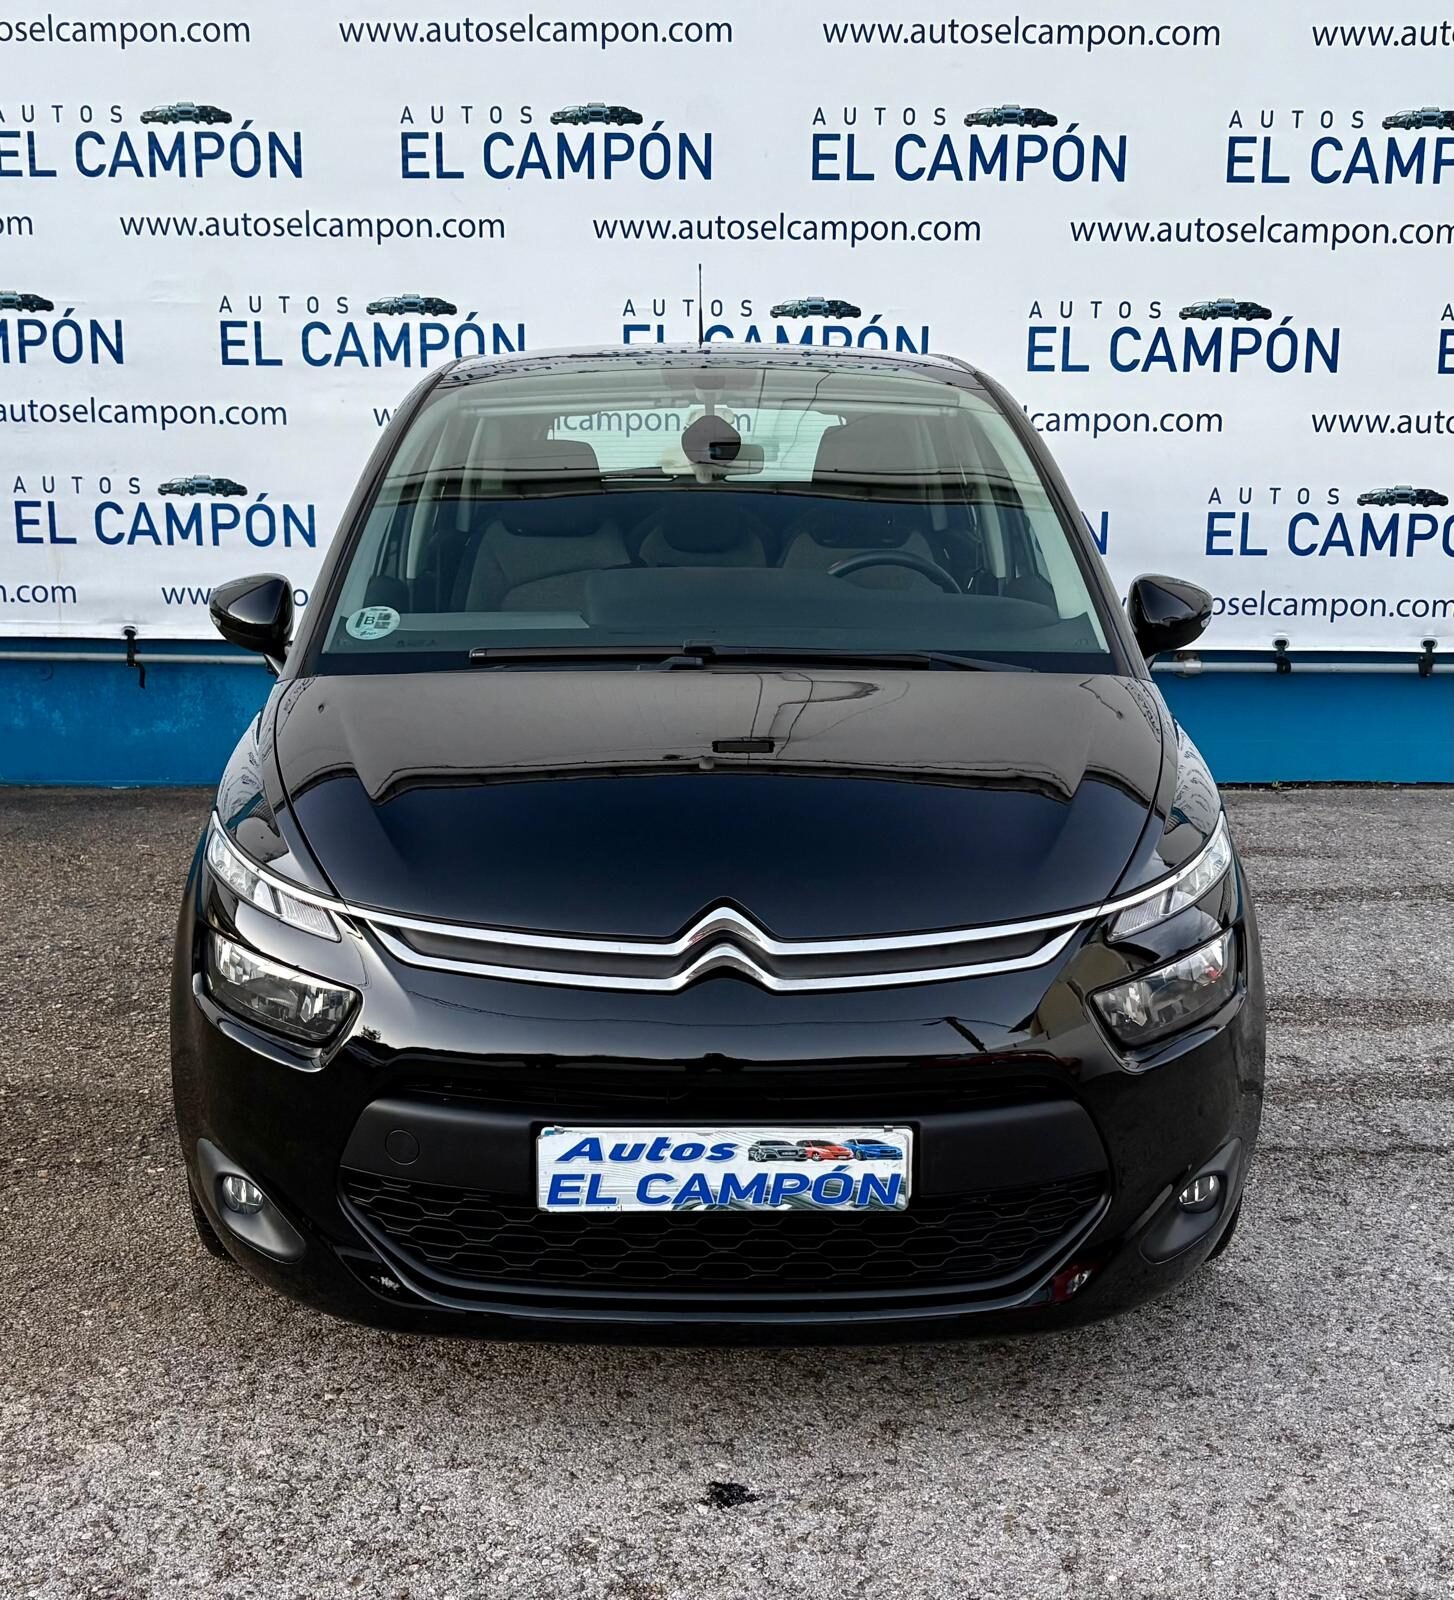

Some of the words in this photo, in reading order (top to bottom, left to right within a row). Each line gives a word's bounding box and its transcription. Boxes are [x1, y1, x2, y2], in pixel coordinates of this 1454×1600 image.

[338, 13, 732, 50] www.autoselcampon.com
[822, 15, 1220, 53] www.autoselcampon.com
[1312, 20, 1454, 47] www.aut
[400, 105, 533, 125] AUTOS
[812, 106, 946, 126] AUTOS
[1228, 109, 1364, 129] AUTOS
[0, 130, 58, 178] EL
[75, 119, 303, 179] CAMPÓN
[400, 131, 465, 179] EL
[483, 119, 712, 181] CAMPÓN
[811, 133, 875, 181] EL
[894, 122, 1127, 183] CAMPÓN
[1226, 135, 1290, 184] EL
[119, 209, 505, 245] www.autoselcampon.com
[592, 212, 981, 246] www.autoselcampon.com
[1070, 214, 1454, 248] www.autoselcampon.com
[218, 295, 349, 314] AUTOS
[622, 298, 753, 318] AUTOS
[1028, 300, 1162, 319] AUTOS
[0, 308, 124, 364] PÓN
[219, 320, 283, 367] EL
[301, 311, 525, 368] CAMPÓN
[1027, 326, 1090, 373] EL
[1109, 316, 1340, 374] CAMPÓN
[13, 475, 141, 495] AUTOS
[1207, 487, 1340, 507] AUTOS
[14, 500, 78, 545] EL
[94, 491, 317, 548] CAMPÓN
[1205, 511, 1268, 556] EL
[554, 1136, 740, 1163] Autos
[546, 1172, 618, 1206] EL
[635, 1164, 904, 1207] CAMPÓN
